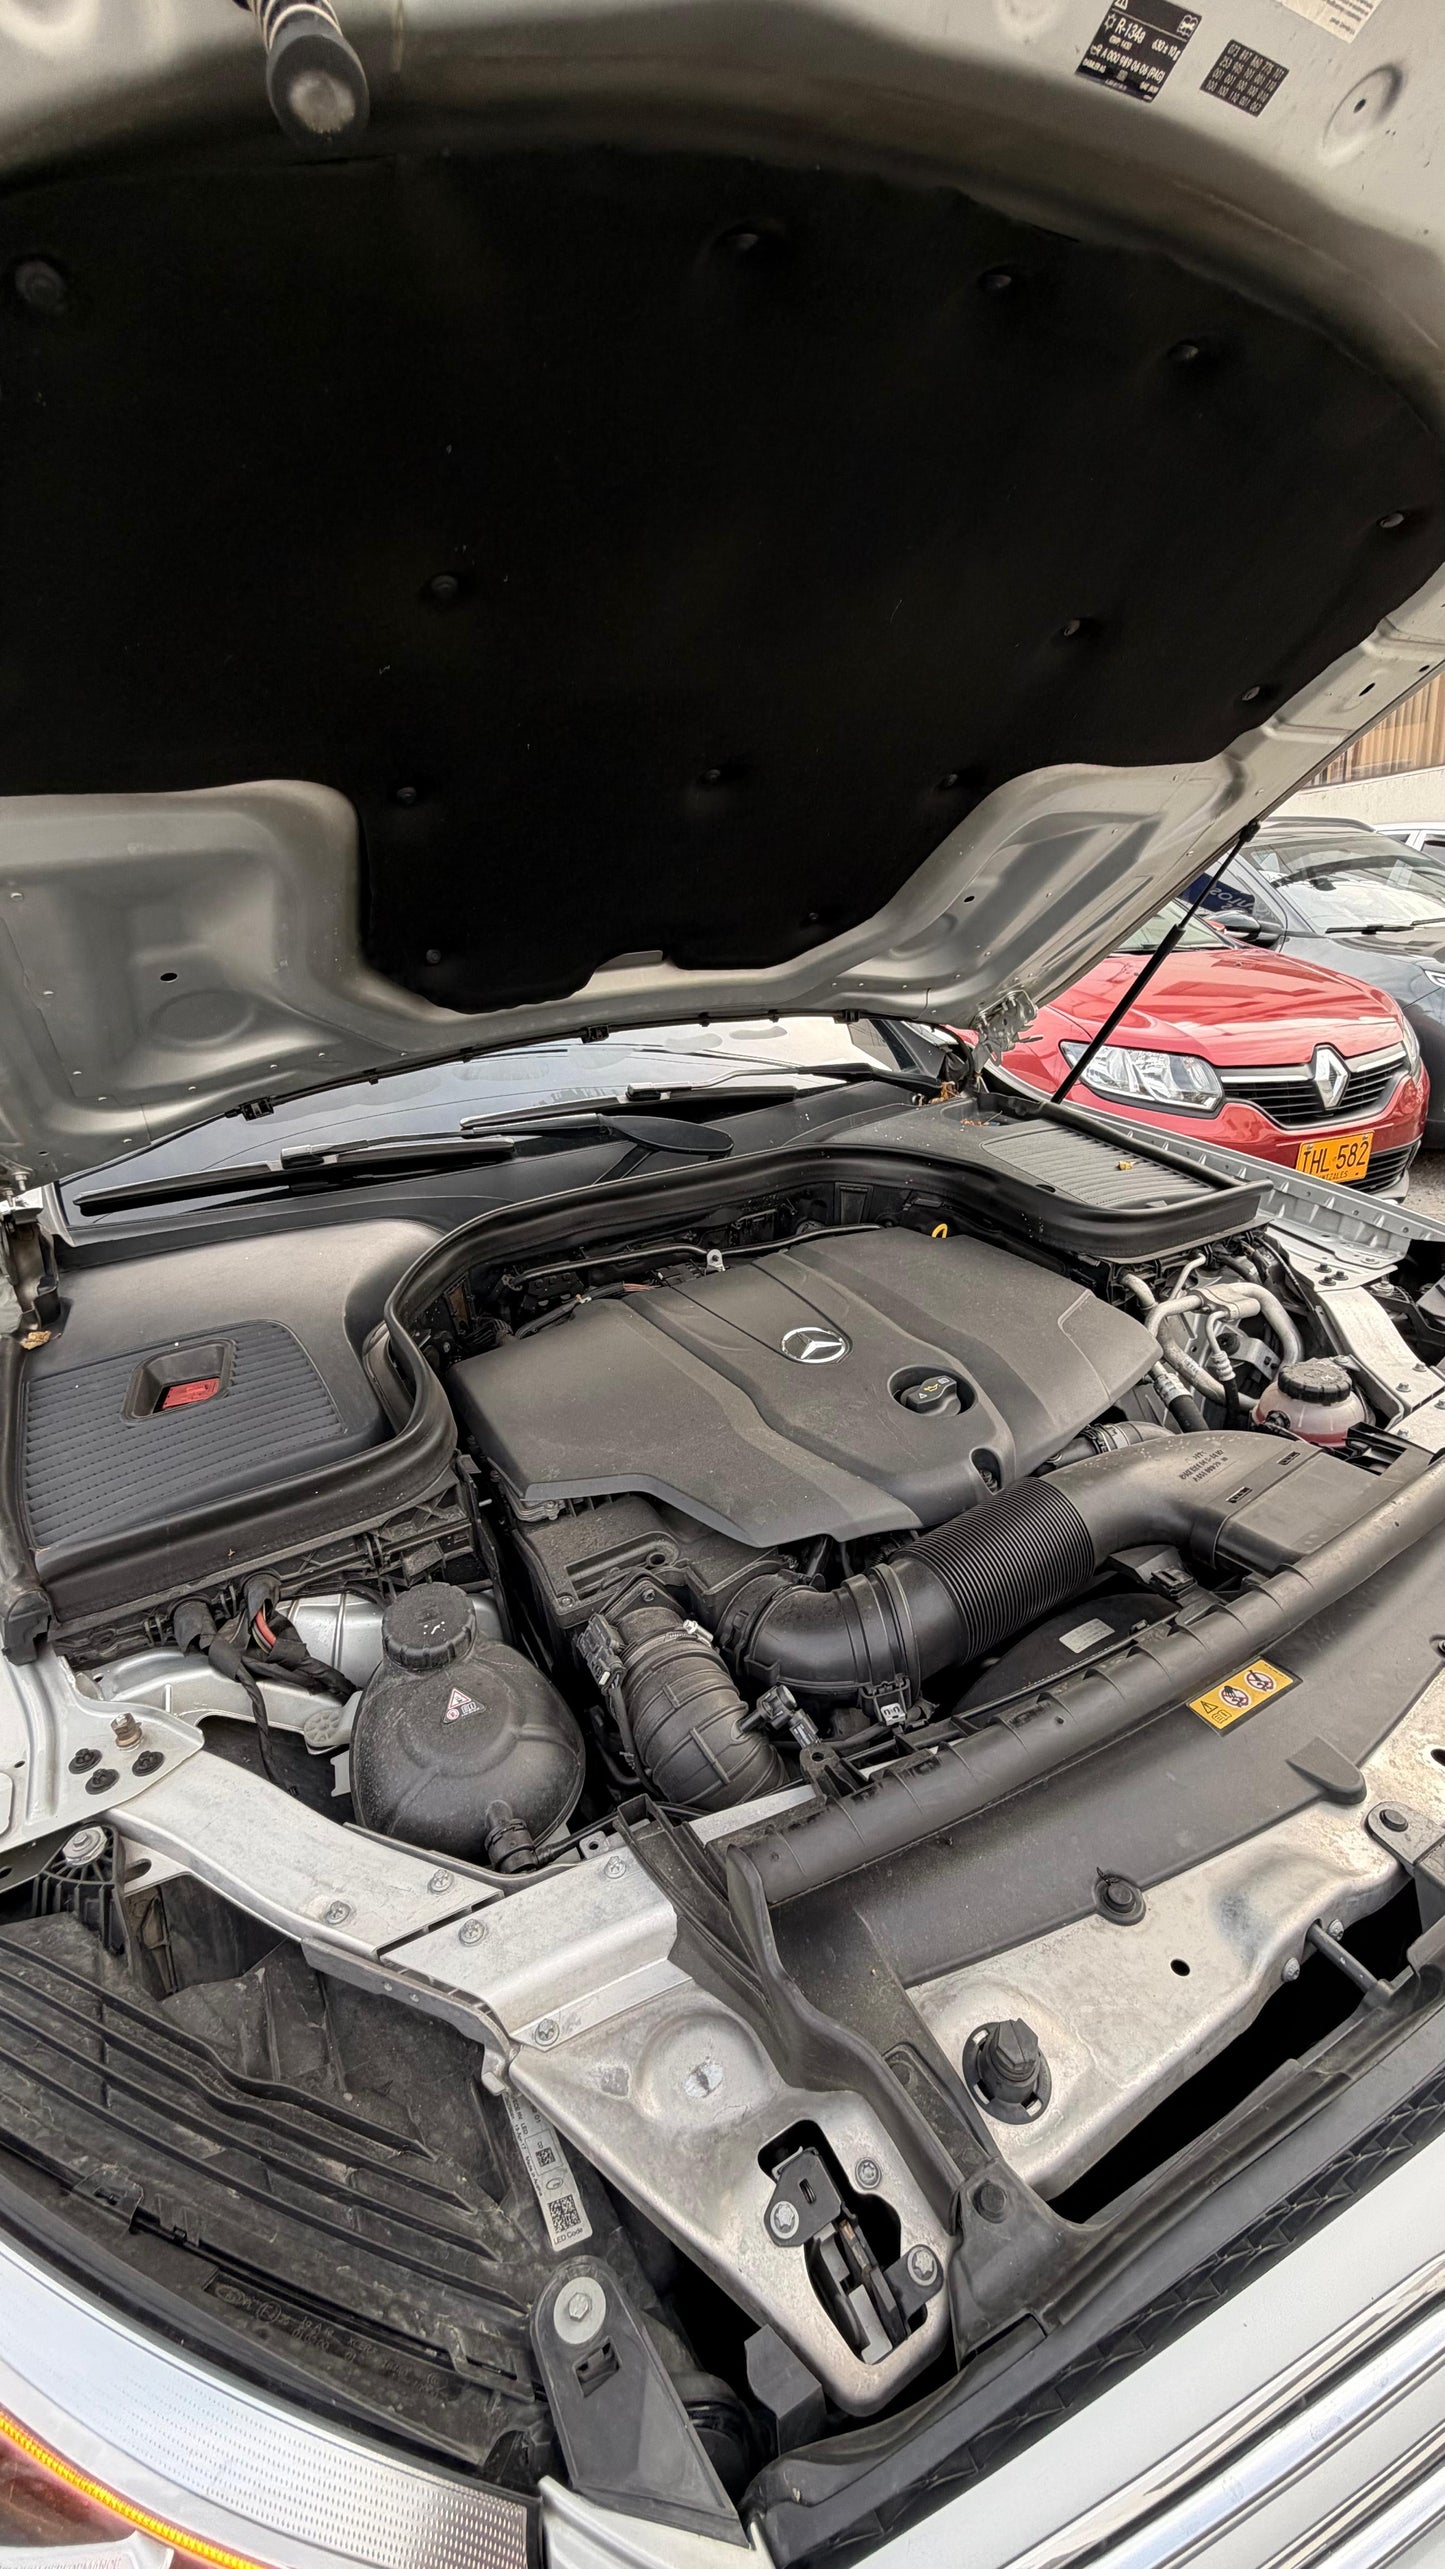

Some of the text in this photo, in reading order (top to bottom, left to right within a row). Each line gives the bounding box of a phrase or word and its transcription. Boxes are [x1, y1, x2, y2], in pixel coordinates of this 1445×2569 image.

[1115, 17, 1147, 44] R-134a
[1100, 48, 1109, 59] A
[1146, 66, 1166, 84] (PAG)
[1303, 1140, 1369, 1174] THL 582
[553, 2227, 584, 2246] LED Code
